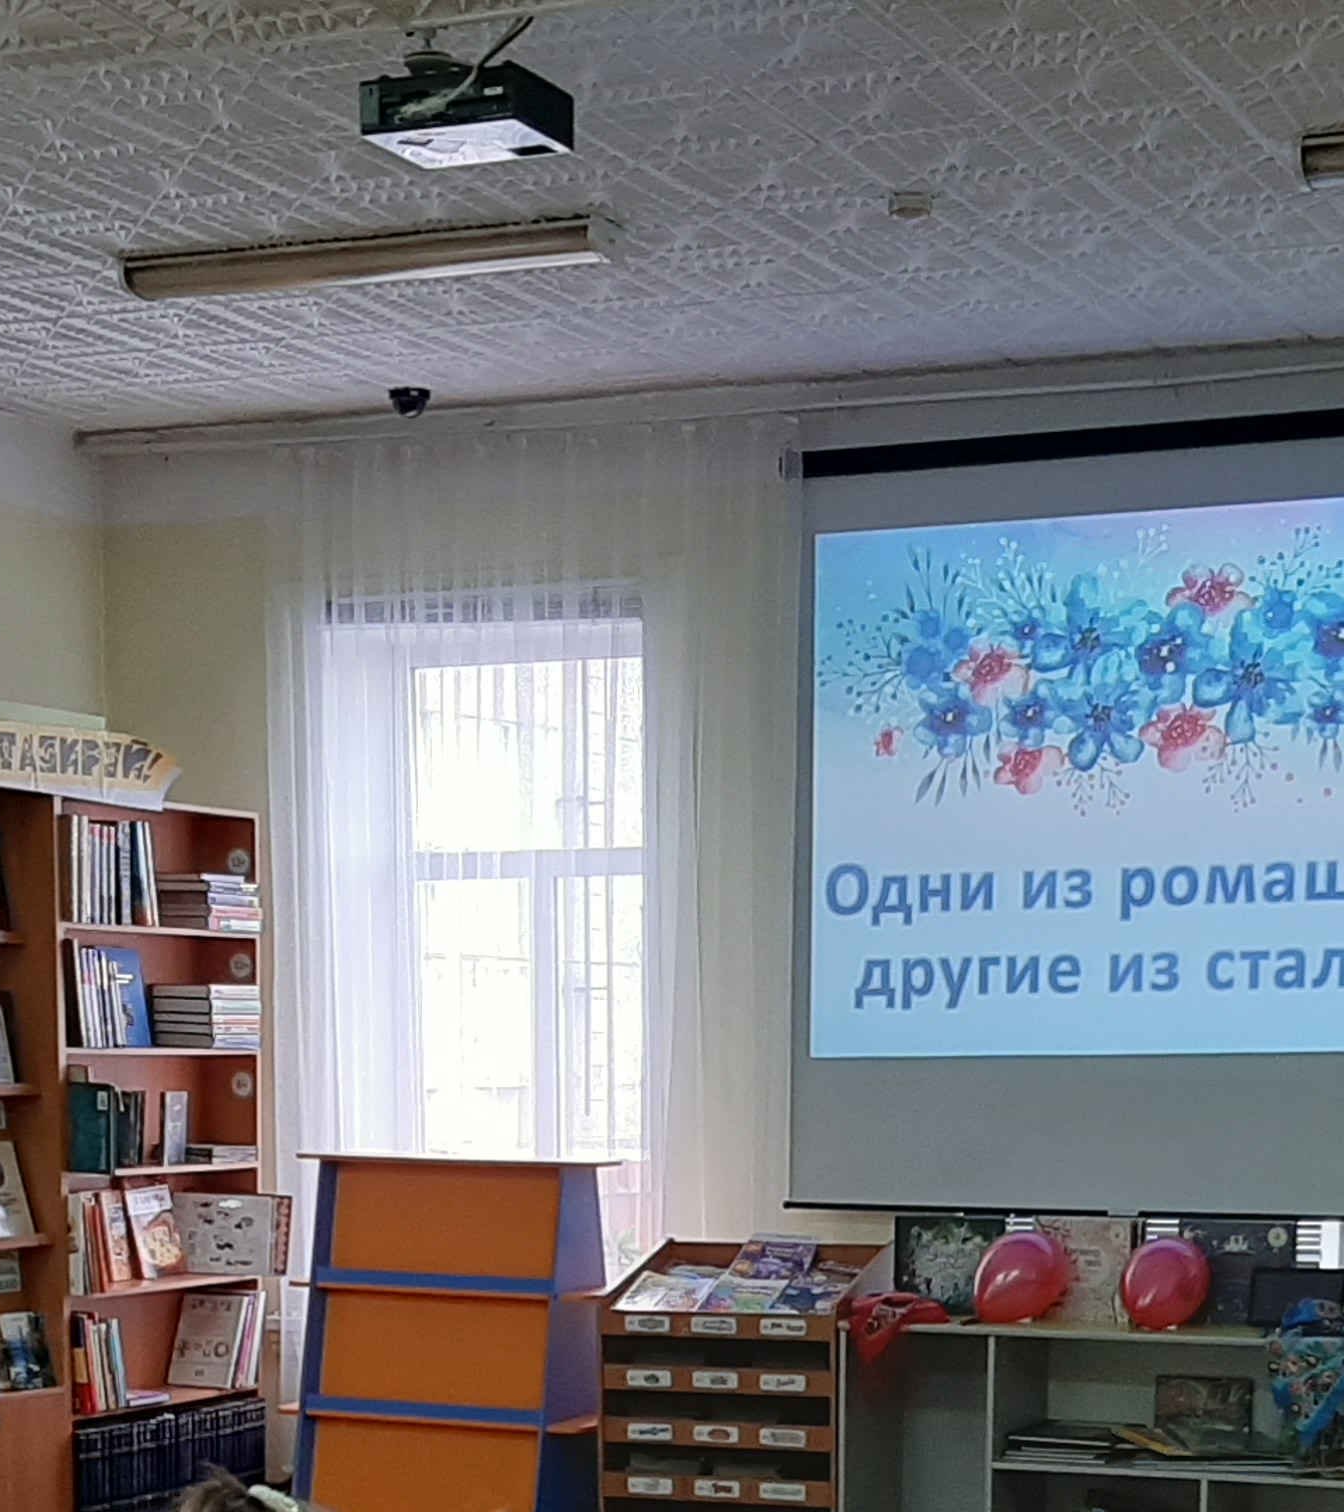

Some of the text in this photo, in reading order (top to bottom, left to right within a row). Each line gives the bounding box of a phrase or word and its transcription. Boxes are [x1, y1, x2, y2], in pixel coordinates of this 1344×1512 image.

[823, 862, 995, 926] Одни
[1022, 867, 1093, 910] из
[854, 951, 1082, 1010] другие
[1108, 952, 1181, 992] из
